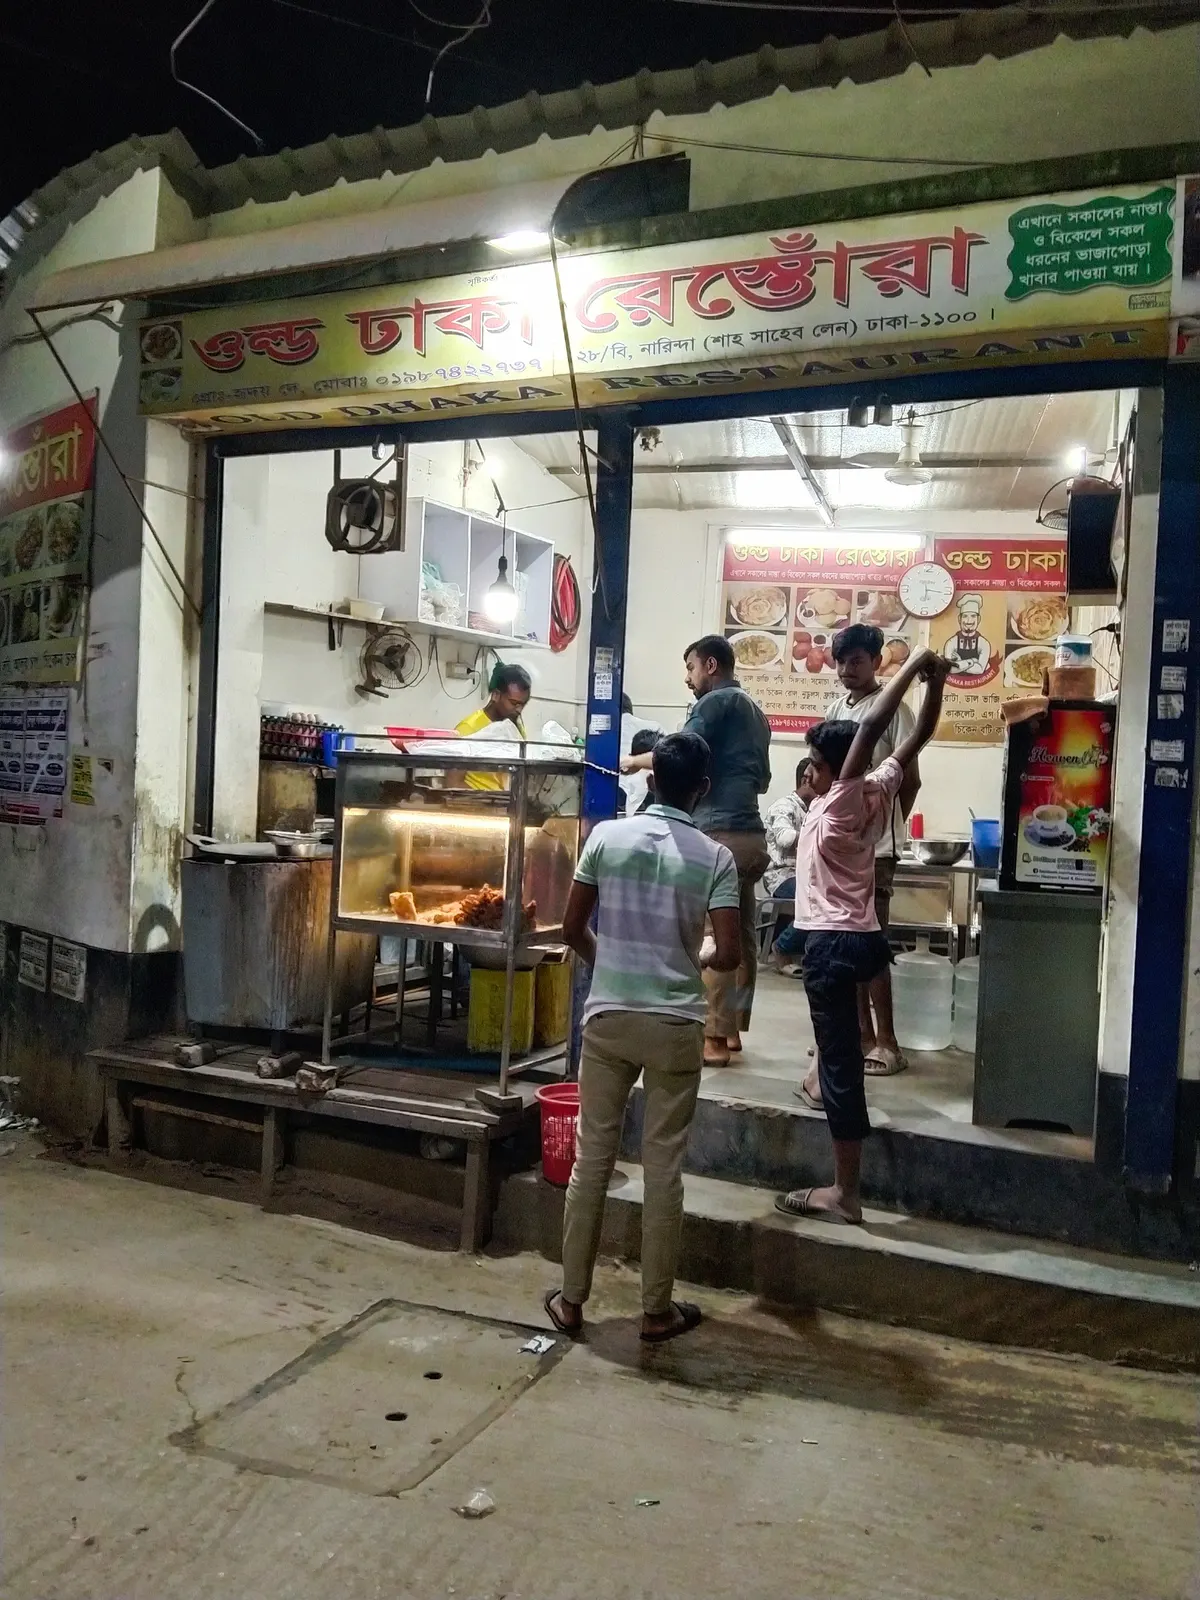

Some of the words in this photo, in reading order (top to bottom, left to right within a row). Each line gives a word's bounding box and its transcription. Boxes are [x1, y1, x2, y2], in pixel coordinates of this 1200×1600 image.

[1018, 213, 1061, 230] এখানে
[1068, 207, 1124, 224] সকালের
[1131, 202, 1162, 217] নাস্তা
[1034, 236, 1044, 246] ও
[1050, 228, 1102, 245] বিকেলে
[1108, 223, 1145, 237] সকল
[1026, 251, 1070, 267] ধরনের
[1075, 241, 1151, 261] ভাজাপোড়া
[1019, 272, 1058, 287] খাবার
[1064, 266, 1107, 281] পাওয়া
[1113, 263, 1138, 277] যায়
[188, 318, 326, 372] ওল্ড
[345, 296, 533, 358] ঢাকা
[576, 226, 990, 333] রেস্তোঁরা
[577, 343, 633, 363] ২৮/বি,
[639, 337, 695, 357] নারিন্দা
[703, 333, 744, 352] (শাহ
[750, 327, 803, 343] সাহেব
[813, 319, 857, 338] লেন)
[866, 311, 977, 332] ঢাকা-১১০০
[210, 410, 322, 424] OLD
[337, 386, 563, 417] DHAKA
[593, 328, 1147, 390] RESTAURANT
[376, 358, 542, 385] ০১৯৮৭৪২২৭৩৭
[780, 546, 824, 566] ঢাকা
[941, 551, 993, 570] ওল্ড
[1002, 549, 1067, 573] ঢাকা
[963, 579, 989, 587] সকালের
[992, 579, 1007, 587] নাস্তা
[1017, 577, 1041, 587] বিকেলে
[1044, 580, 1060, 588] সকল
[963, 670, 996, 686] RESTAURANT
[955, 722, 977, 734] চিকেন
